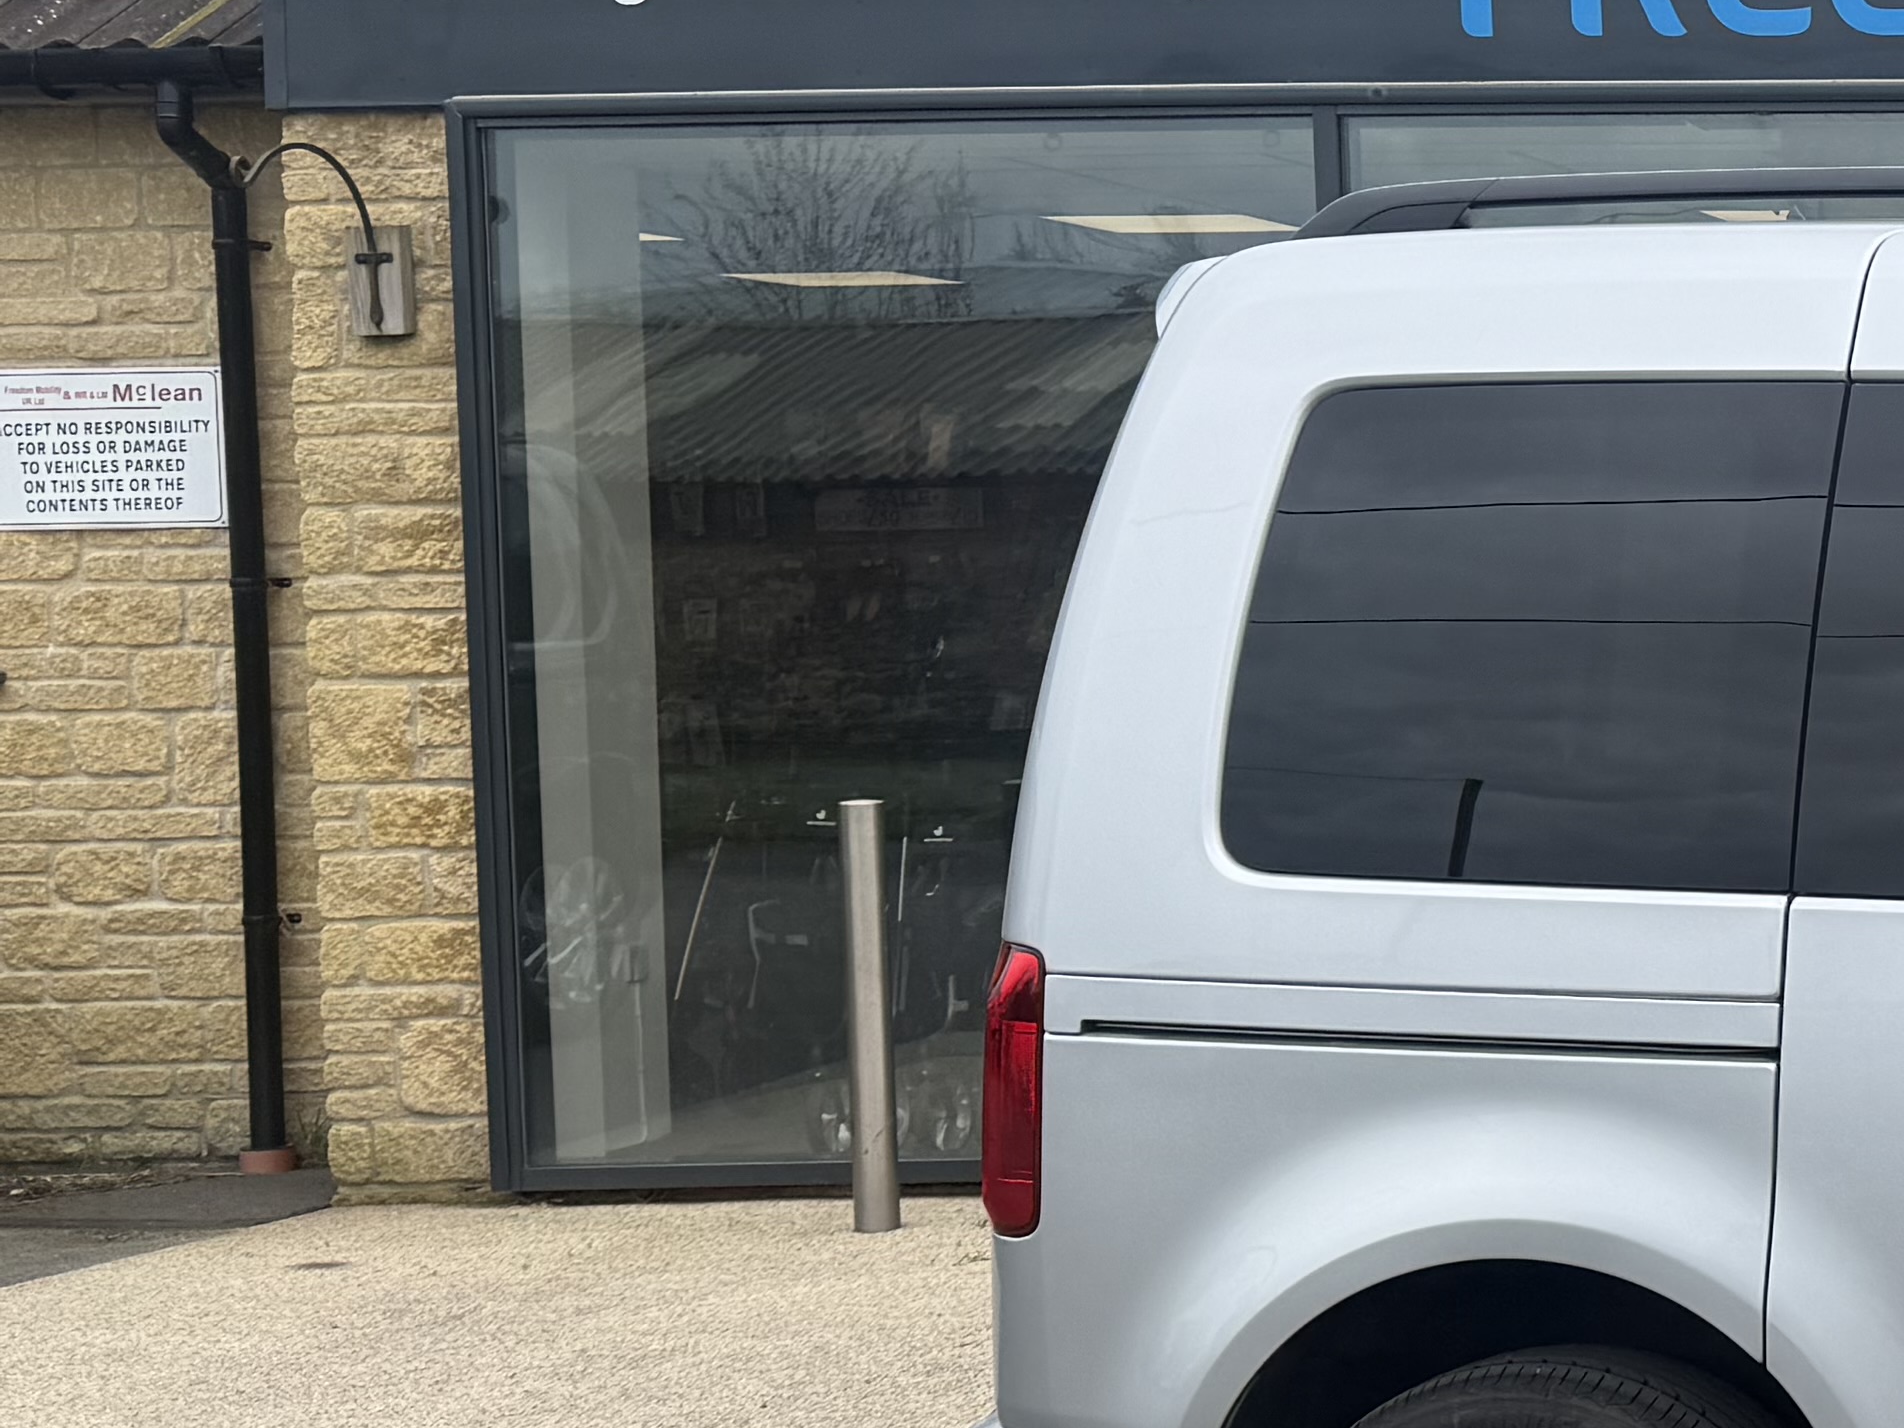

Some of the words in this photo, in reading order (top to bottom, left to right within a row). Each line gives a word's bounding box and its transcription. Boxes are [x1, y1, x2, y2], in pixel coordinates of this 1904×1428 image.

[0, 422, 51, 437] CCEPT
[57, 422, 79, 435] NO
[84, 419, 210, 436] RESPONSIBILITY
[18, 441, 46, 456] FOR
[52, 440, 91, 455] LOSS
[96, 440, 117, 455] OR
[123, 439, 188, 454] DAMAGE
[20, 461, 40, 475] TO
[44, 459, 119, 475] VEHICLES
[125, 458, 186, 473] PARKED
[24, 480, 46, 494] ON
[51, 479, 86, 493] THIS
[91, 478, 124, 493] SITE
[129, 478, 150, 492] OR
[155, 477, 186, 491] THE
[26, 498, 109, 513] CONTENTS
[113, 496, 184, 512] THEREOF
